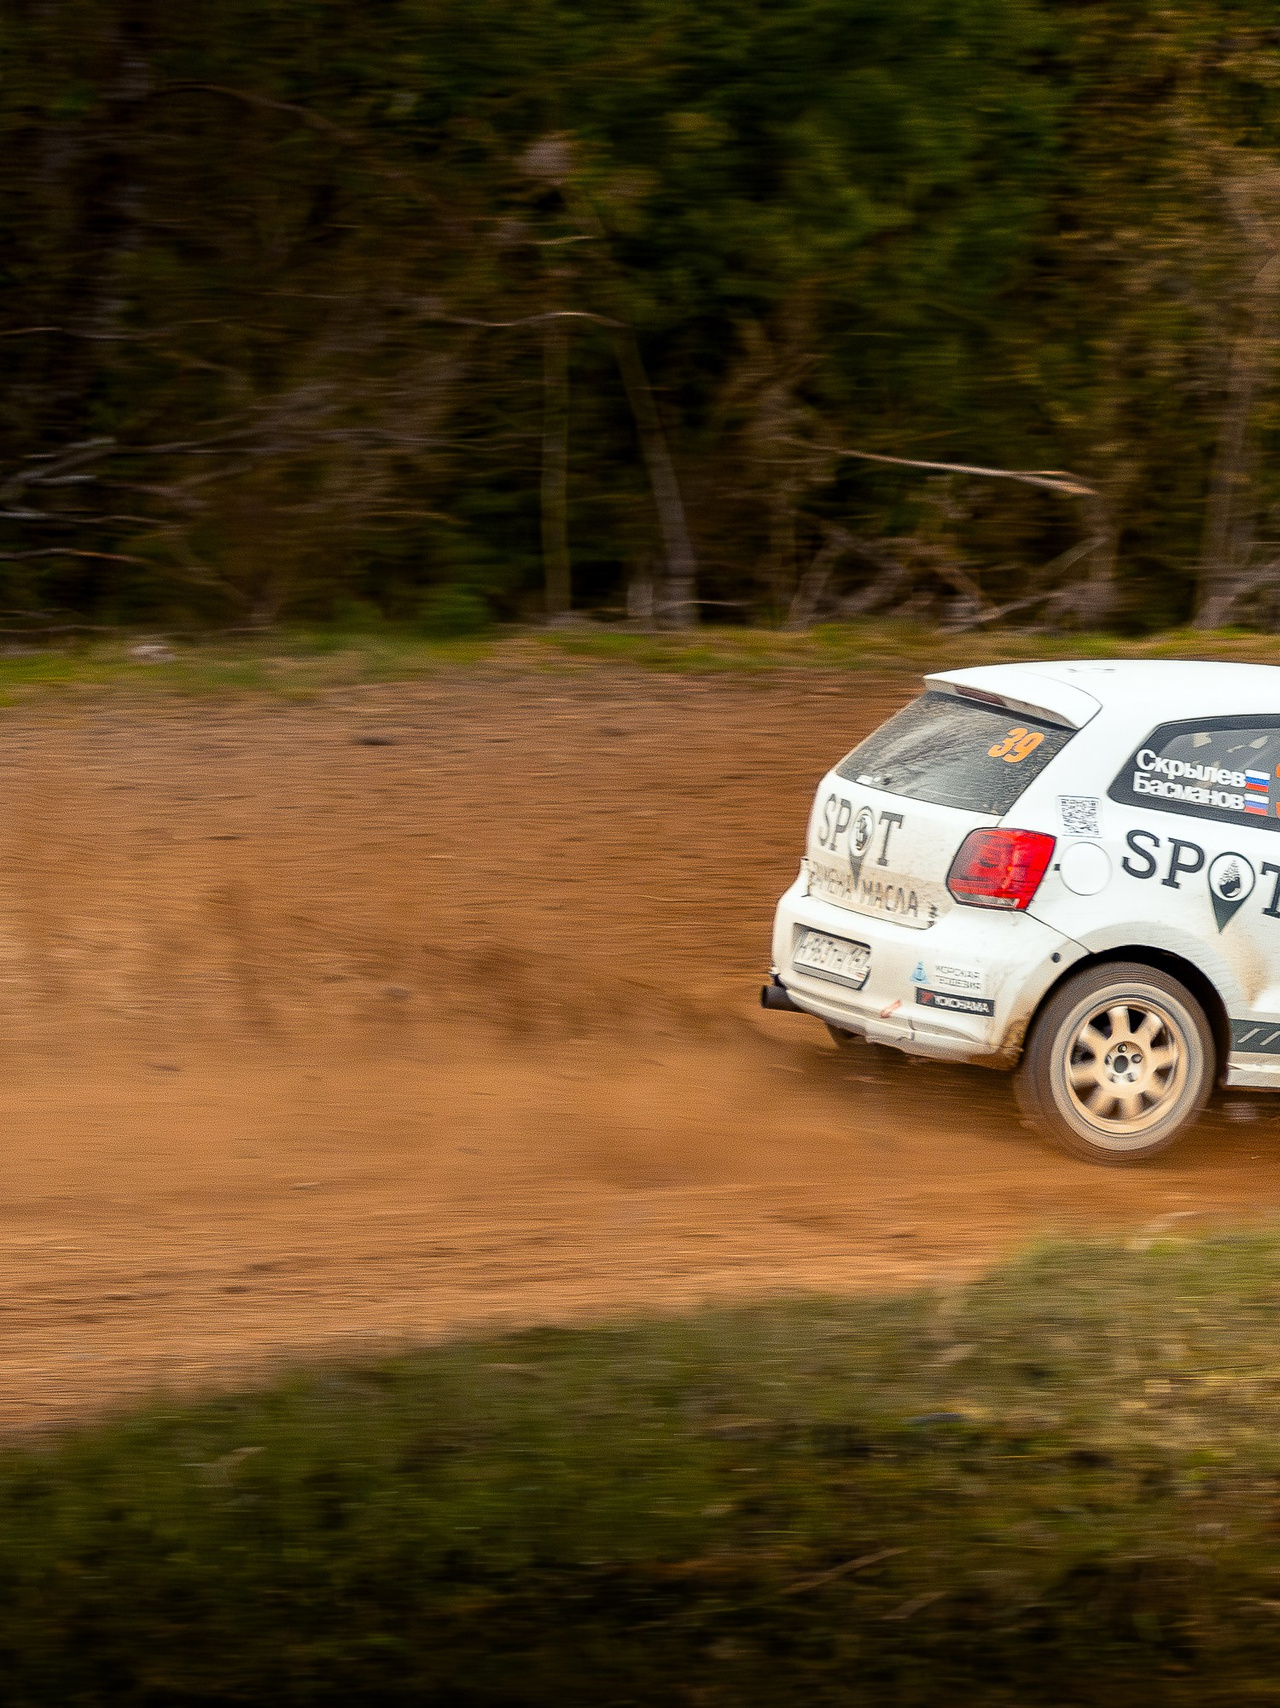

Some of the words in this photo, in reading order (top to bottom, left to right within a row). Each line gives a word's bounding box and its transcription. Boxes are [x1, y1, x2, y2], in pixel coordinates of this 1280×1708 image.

[987, 727, 1045, 763] 39
[1136, 748, 1246, 788] Скрылев
[1132, 771, 1245, 810] Басманов
[818, 793, 905, 885] SPOT
